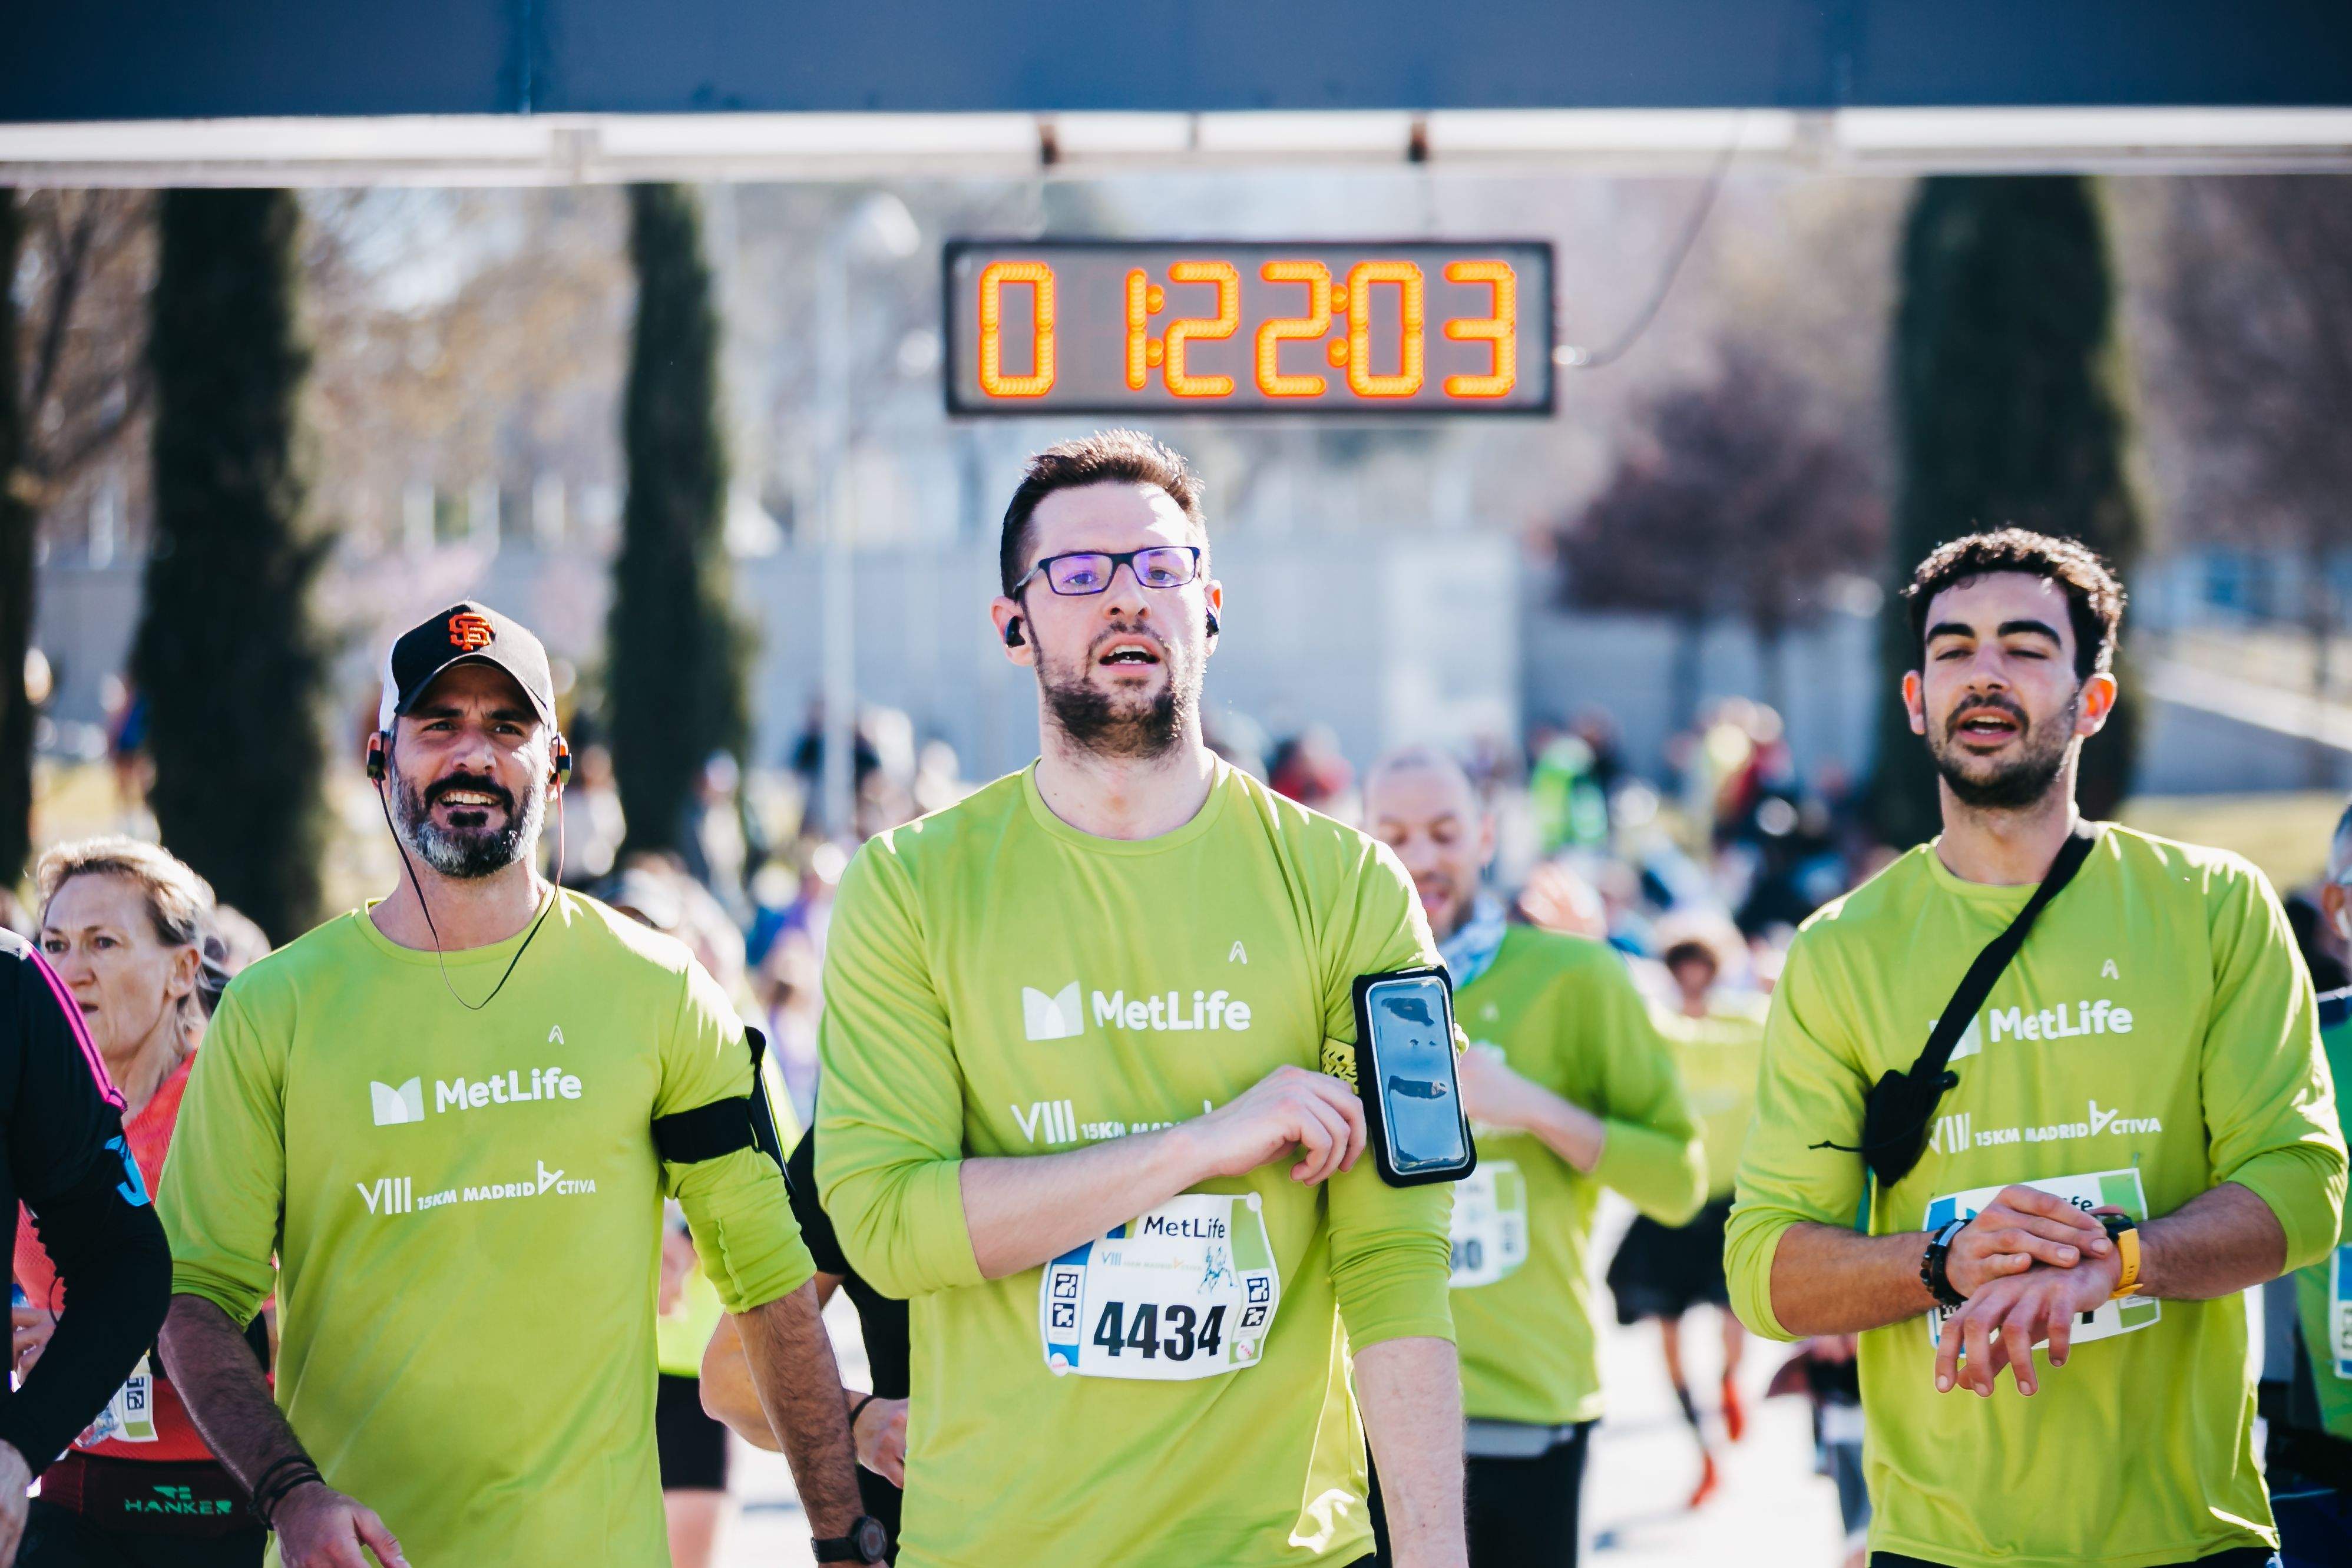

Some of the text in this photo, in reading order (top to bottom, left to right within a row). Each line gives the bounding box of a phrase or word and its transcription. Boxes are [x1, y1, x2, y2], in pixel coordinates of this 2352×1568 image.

[1091, 990, 1251, 1031] MetLife
[1990, 1000, 2133, 1043] MetLife
[436, 1067, 583, 1113] MetLife
[1011, 1100, 1077, 1144] VIII
[1975, 1127, 2020, 1146] 15KM
[2025, 1123, 2088, 1142] MADRID
[356, 1177, 412, 1215] VIII
[417, 1189, 457, 1210] 15KM
[464, 1182, 535, 1202] MADRID
[1144, 1216, 1225, 1238] MetLife
[1101, 1251, 1122, 1266] VIII
[1093, 1301, 1227, 1361] 4434
[125, 1499, 232, 1515] HANKER
